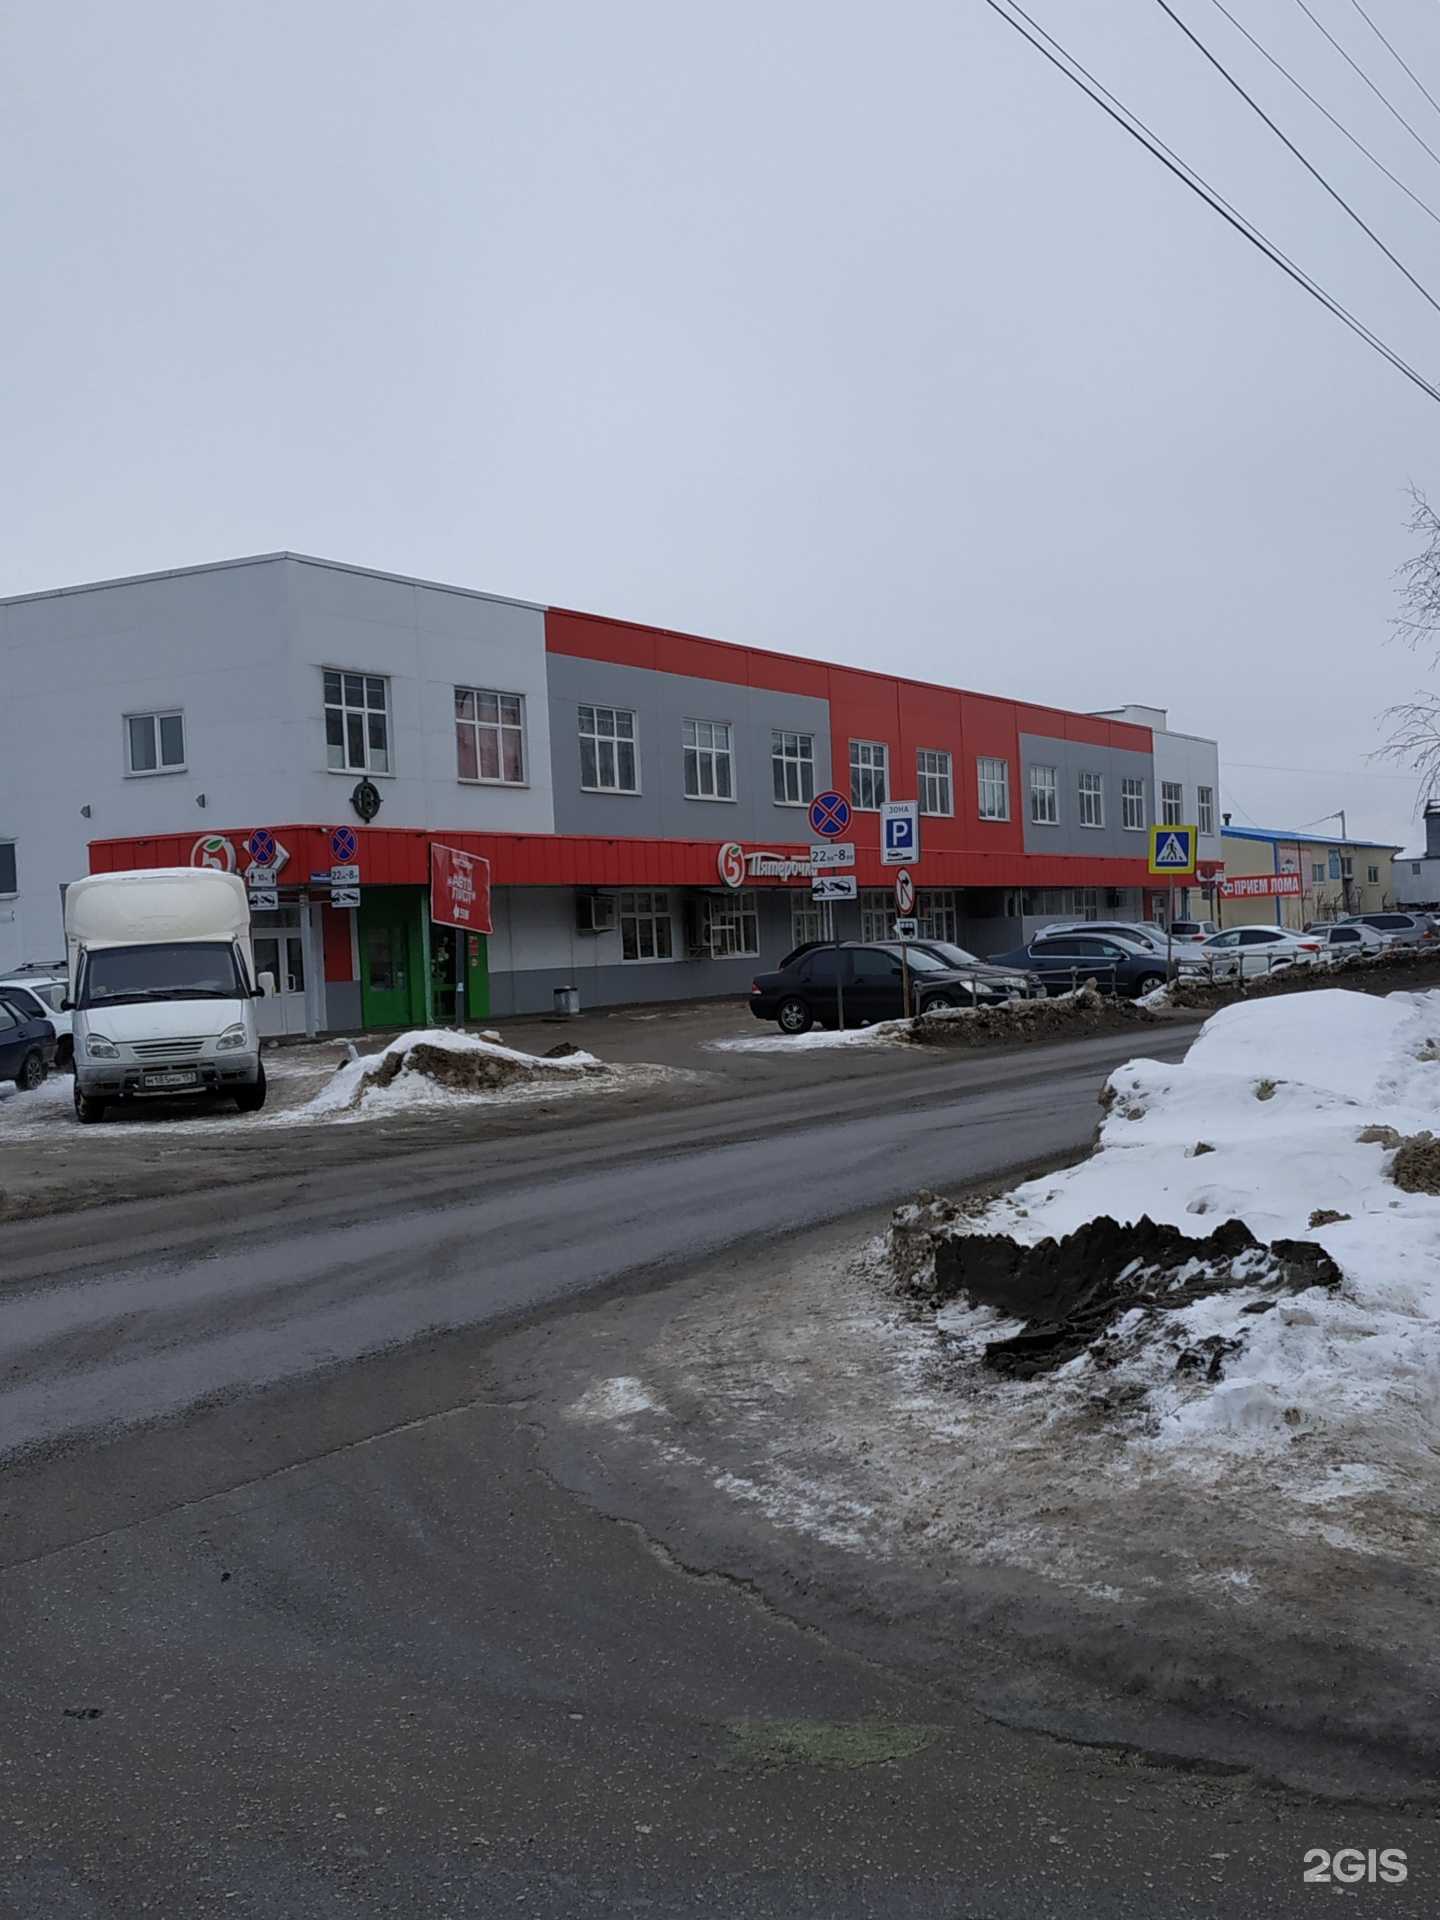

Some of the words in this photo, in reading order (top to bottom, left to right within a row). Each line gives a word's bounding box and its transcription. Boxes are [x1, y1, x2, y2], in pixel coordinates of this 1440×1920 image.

[888, 805, 909, 814] ЗОНА
[1234, 878, 1268, 895] ПРИЕМ
[1270, 876, 1299, 893] ЛОМА
